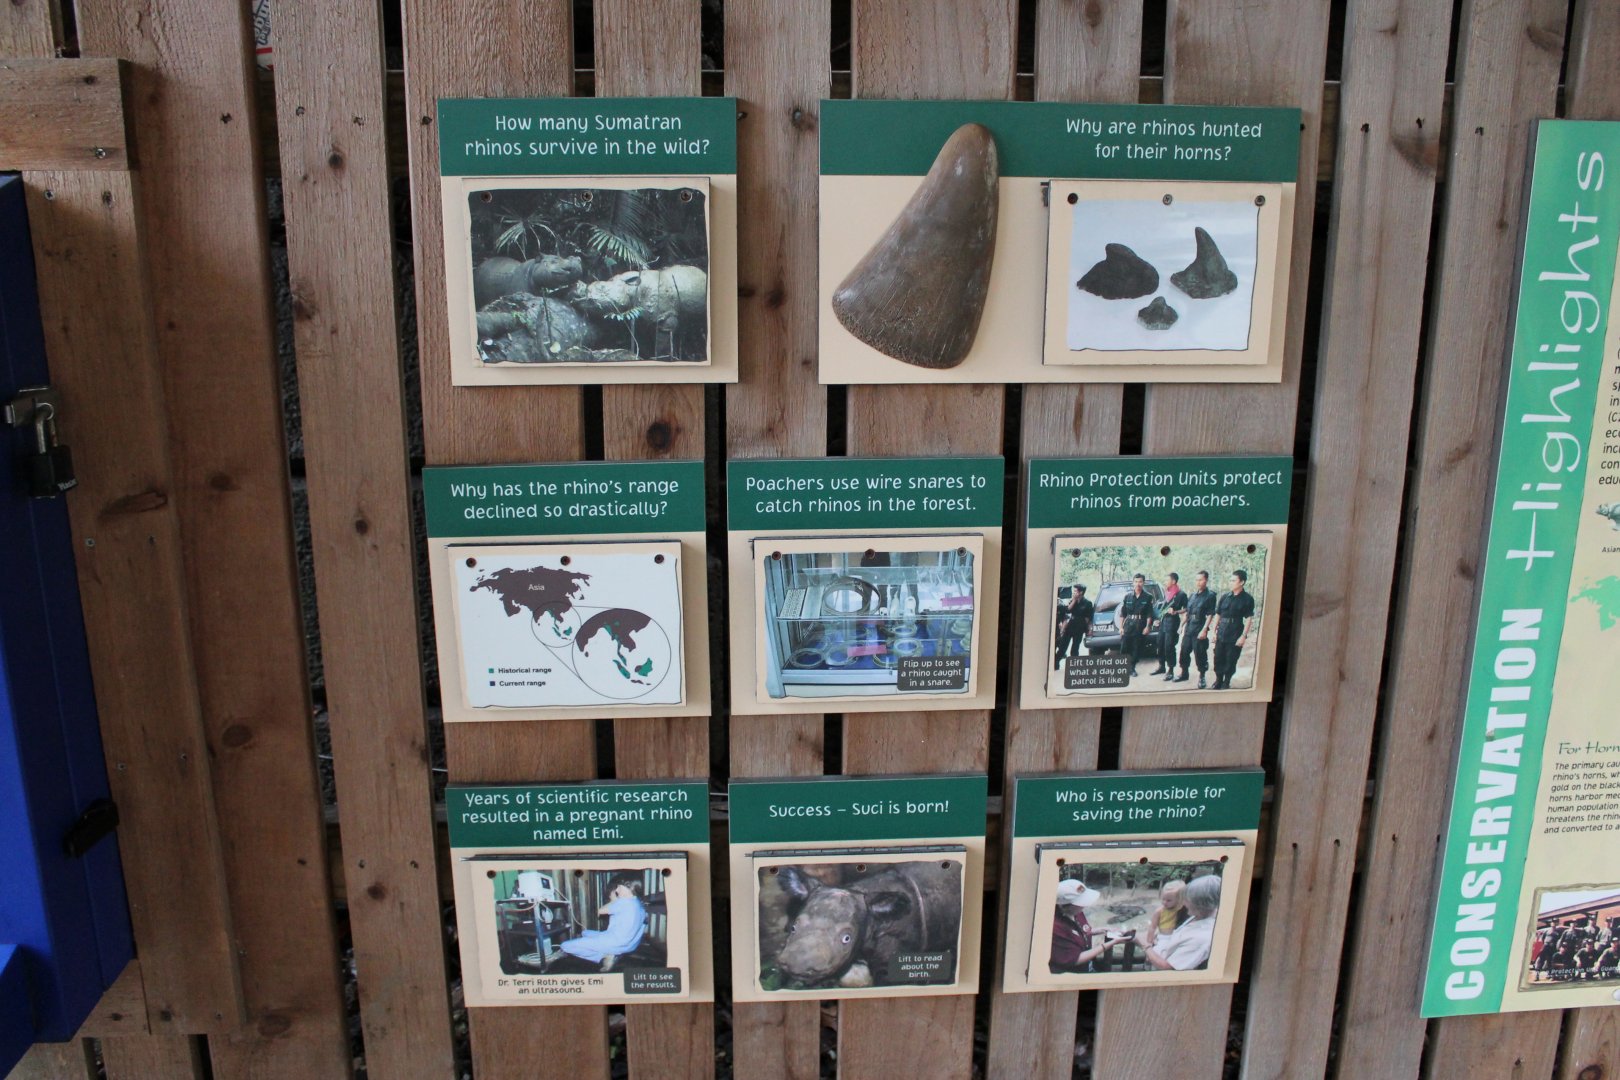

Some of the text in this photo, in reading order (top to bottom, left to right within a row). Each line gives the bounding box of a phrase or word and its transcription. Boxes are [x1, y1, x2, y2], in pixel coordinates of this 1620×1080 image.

[496, 114, 681, 132] How many Sumatran
[1066, 119, 1262, 138] Why are rhinos hunted
[465, 139, 709, 156] rhinos survive in the wild?
[1095, 143, 1231, 161] for their horns?
[1601, 461, 1619, 469] con
[746, 474, 986, 491] Poachers use wire snares to
[1040, 471, 1282, 487] Rhino Protection Units protect
[1599, 477, 1620, 485] edu
[451, 483, 486, 499] Why
[493, 482, 522, 496] has
[530, 481, 557, 496] the
[629, 480, 678, 496] range
[756, 496, 976, 513] catch rhinos in the forest.
[1071, 493, 1250, 509] rhinos from poachers.
[464, 501, 667, 519] declined so drastically?
[1444, 152, 1604, 1000] CONSERVATION Highlights
[904, 660, 918, 668] Flip
[933, 669, 962, 677] caught
[1071, 678, 1096, 686] patrol
[1559, 742, 1581, 755] For
[1571, 761, 1604, 770] primary
[1056, 786, 1225, 803] Who is responsible for
[1551, 784, 1569, 793] gold
[465, 789, 687, 808] Years of scientific research
[1549, 794, 1572, 802] horns
[462, 806, 692, 824] resulted in a pregnant rhino
[769, 805, 831, 818] Success
[852, 801, 883, 815] Suci
[889, 800, 900, 814] is
[907, 800, 949, 814] born!
[1073, 805, 1206, 822] saving the rhino?
[1576, 802, 1618, 812] population
[1546, 814, 1584, 823] threatens
[1603, 812, 1620, 820] rhin
[534, 826, 623, 840] named Emi.
[1562, 824, 1603, 832] converted
[631, 981, 644, 989] the
